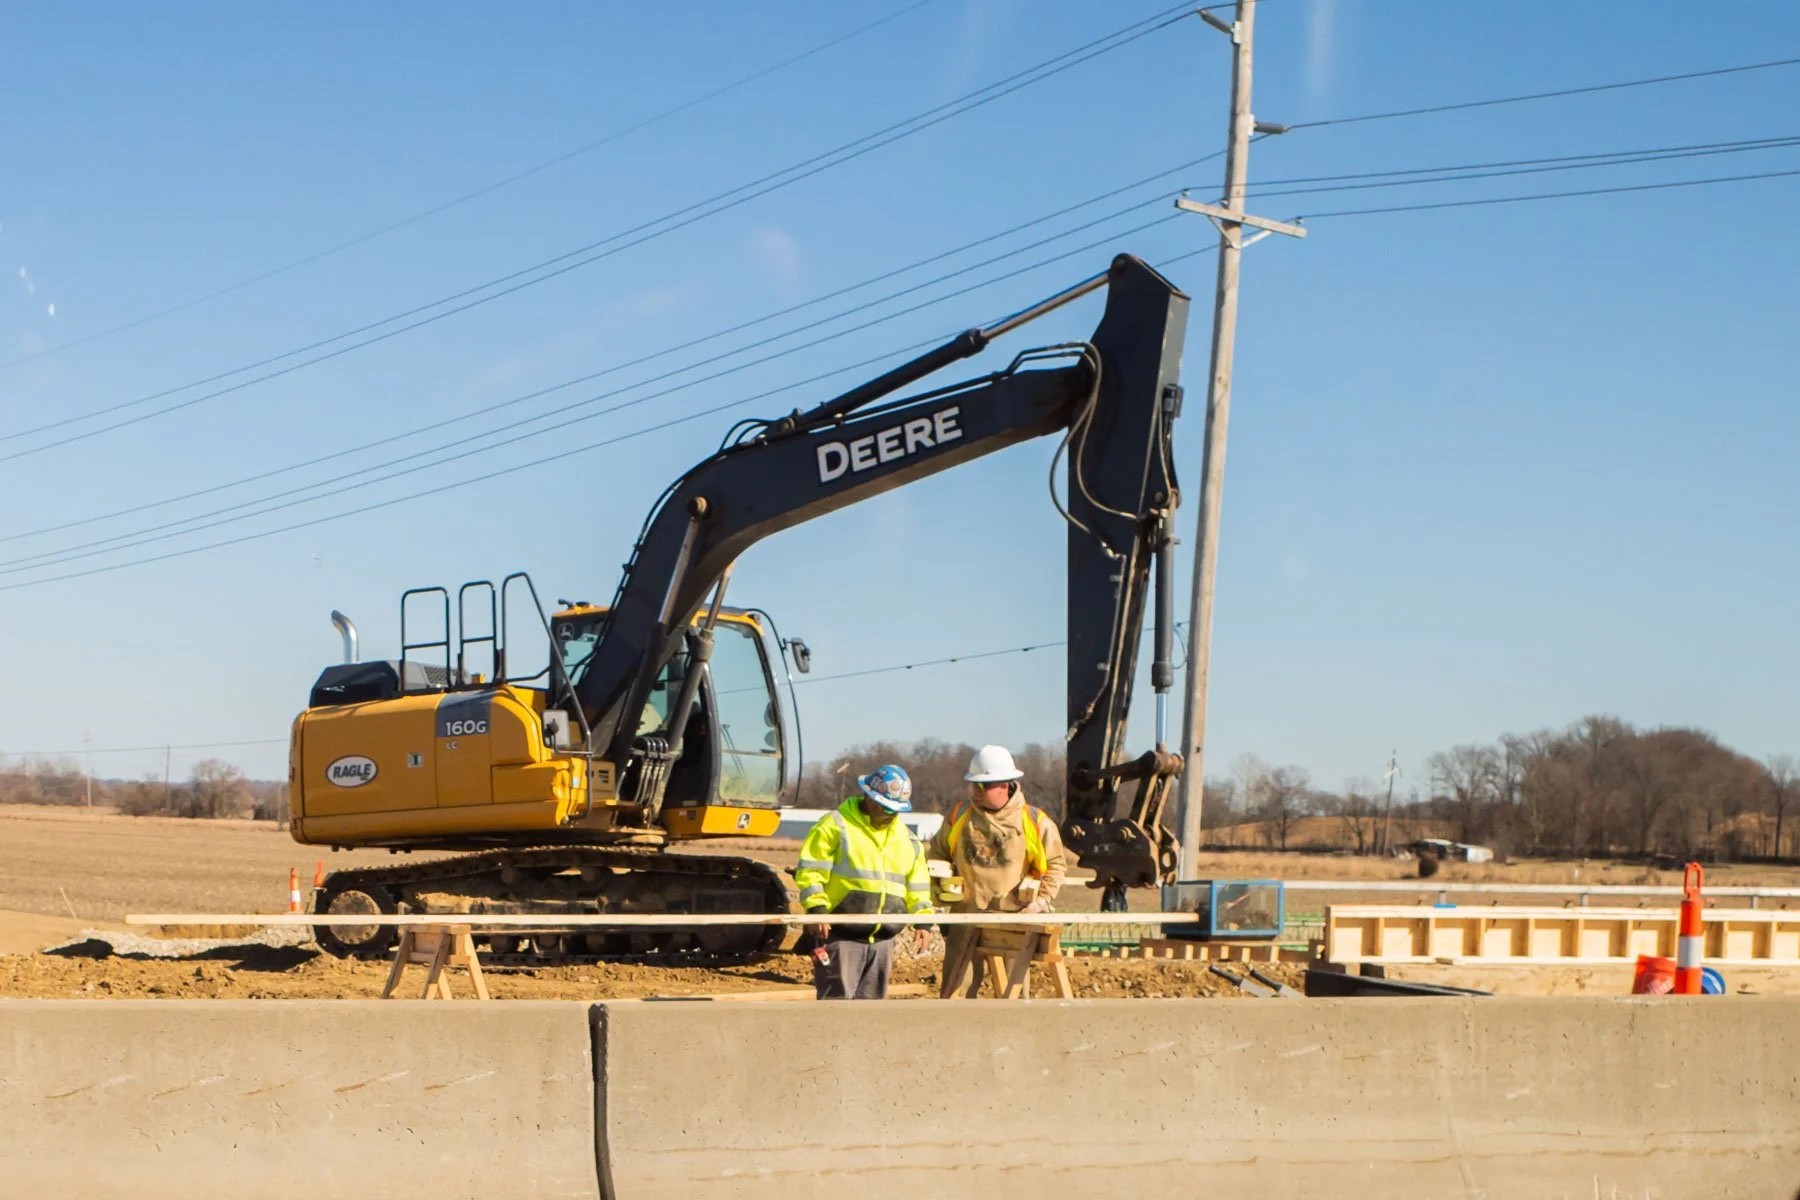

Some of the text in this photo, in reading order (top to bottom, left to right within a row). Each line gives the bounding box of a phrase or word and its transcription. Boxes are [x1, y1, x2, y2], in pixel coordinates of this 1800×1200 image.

[816, 406, 963, 483] DEERE
[446, 720, 487, 735] 160G
[333, 763, 371, 778] RAGLE
